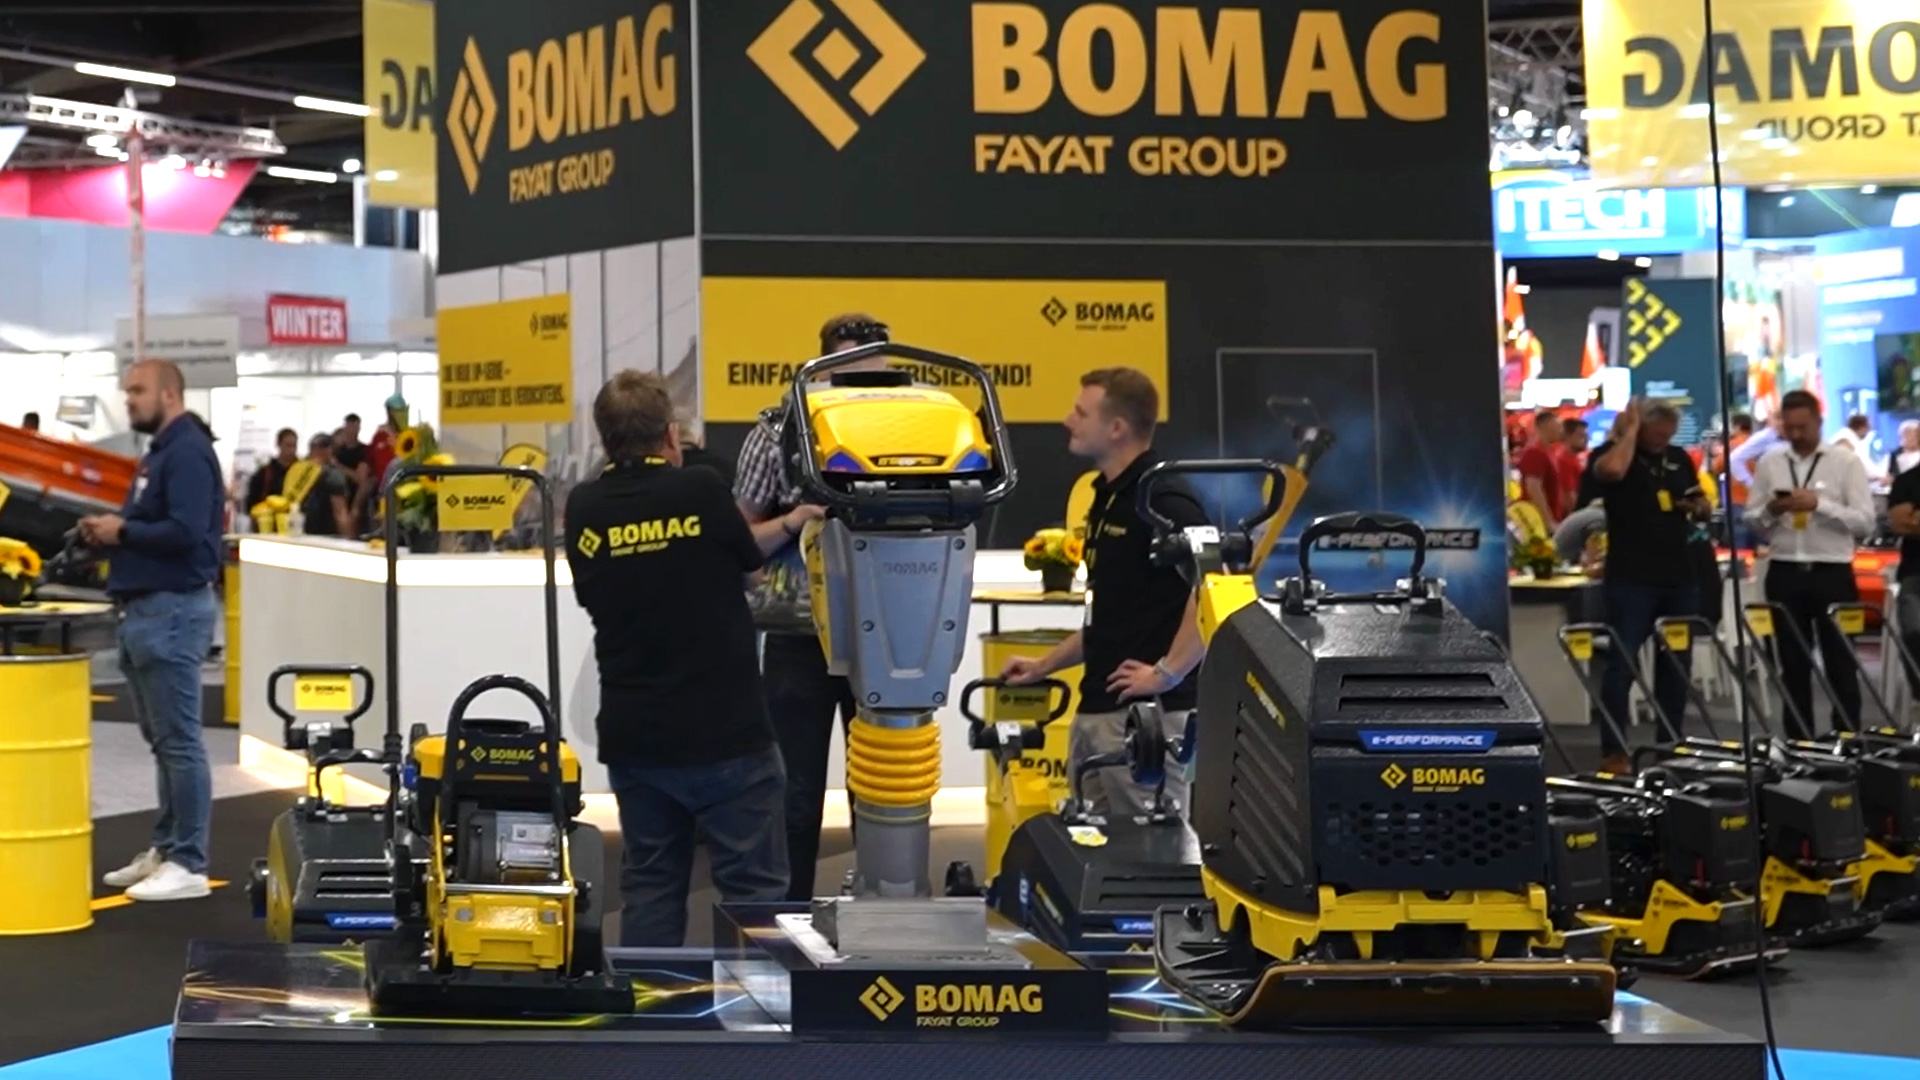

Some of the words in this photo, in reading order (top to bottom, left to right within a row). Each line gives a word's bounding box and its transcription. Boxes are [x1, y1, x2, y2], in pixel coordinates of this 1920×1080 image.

[972, 3, 1448, 121] BOMAG
[508, 3, 677, 152] BOMAG
[974, 135, 1113, 174] FAYAT
[1128, 136, 1287, 177] GROUP
[509, 160, 554, 204] FAYAT
[557, 148, 615, 193] GROUP
[271, 305, 346, 339] WINTER
[1076, 302, 1154, 322] BOMAG
[728, 363, 806, 386] EINFA
[608, 515, 700, 547] BOMAG
[490, 748, 535, 761] BOMAG
[1371, 734, 1484, 746] e-PERFORMANCE
[1412, 768, 1485, 785] BOMAG
[916, 984, 1043, 1013] BOMAG
[916, 1016, 953, 1027] FAYAT
[956, 1016, 1000, 1027] GROUP
